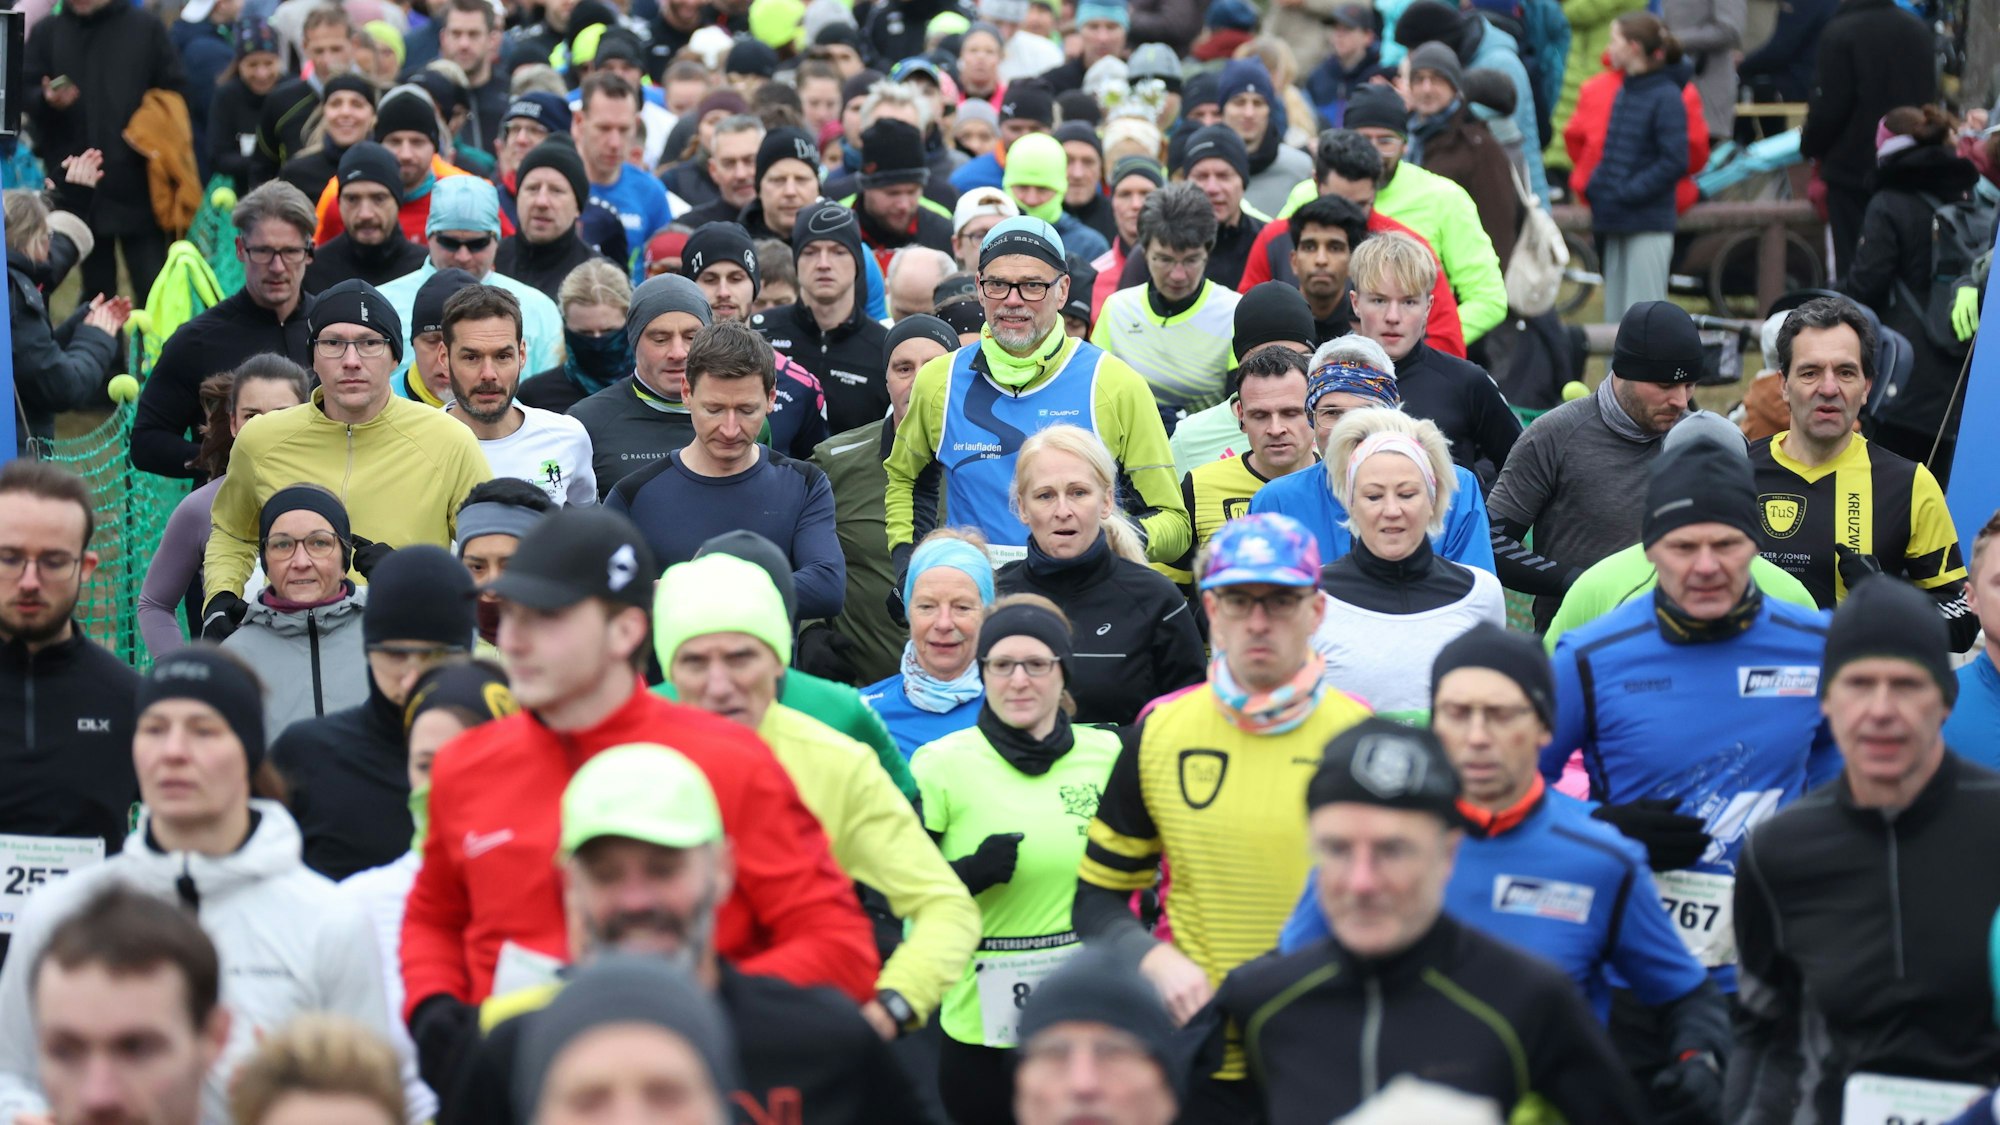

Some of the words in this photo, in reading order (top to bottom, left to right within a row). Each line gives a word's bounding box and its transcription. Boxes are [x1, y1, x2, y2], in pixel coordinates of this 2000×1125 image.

[691, 251, 703, 273] 27
[953, 442, 964, 451] der
[965, 442, 1002, 452] laufladen
[630, 452, 670, 460] RACESKI
[986, 452, 1001, 460] alfter
[1770, 505, 1795, 518] TuS
